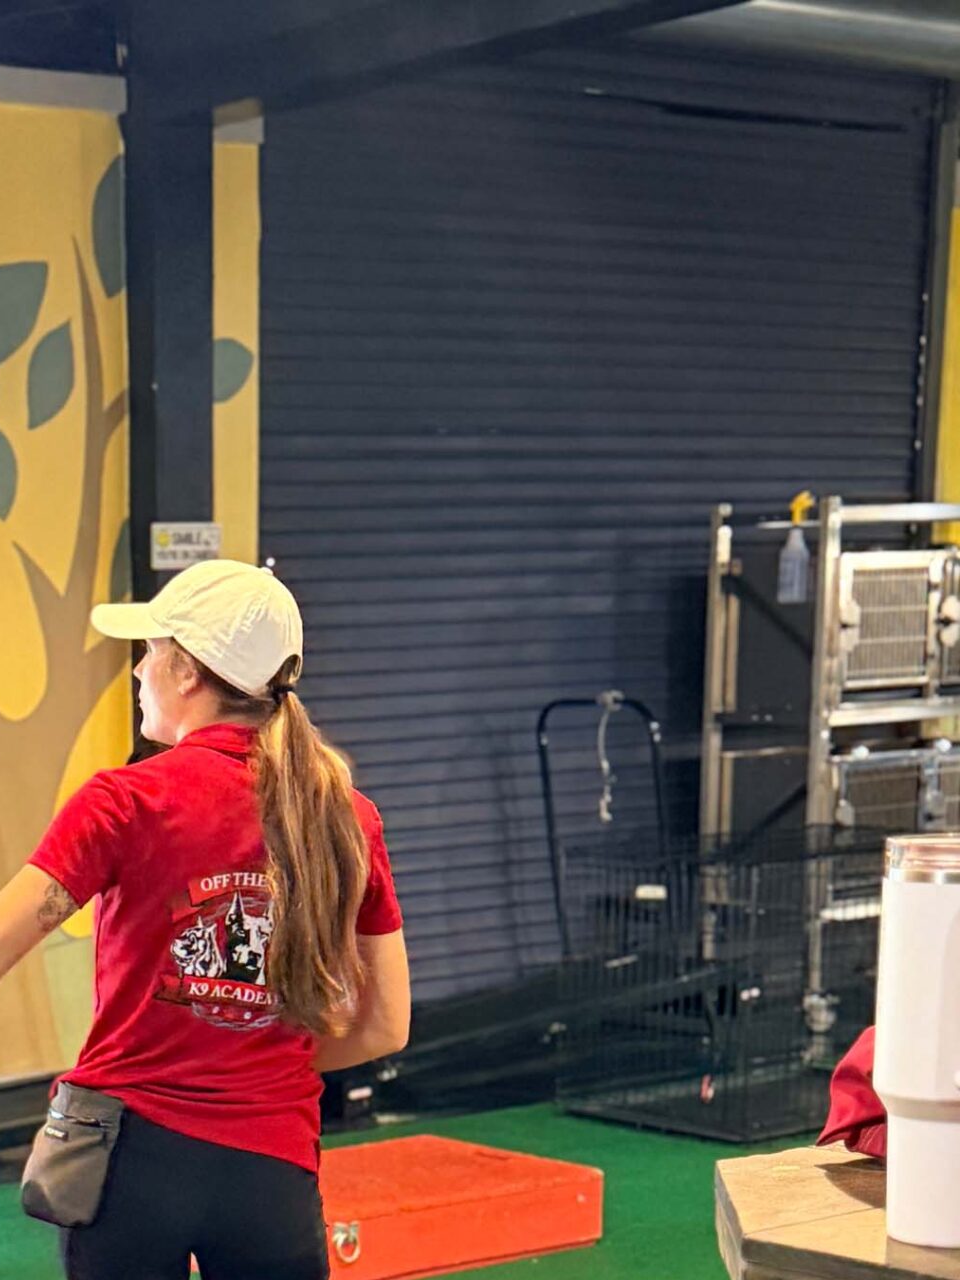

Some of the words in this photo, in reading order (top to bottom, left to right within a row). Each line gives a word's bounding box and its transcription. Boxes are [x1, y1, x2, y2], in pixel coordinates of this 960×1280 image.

[200, 873, 231, 892] OFF
[233, 872, 269, 888] THE
[189, 982, 209, 996] K9
[210, 985, 280, 1006] ACADEM
